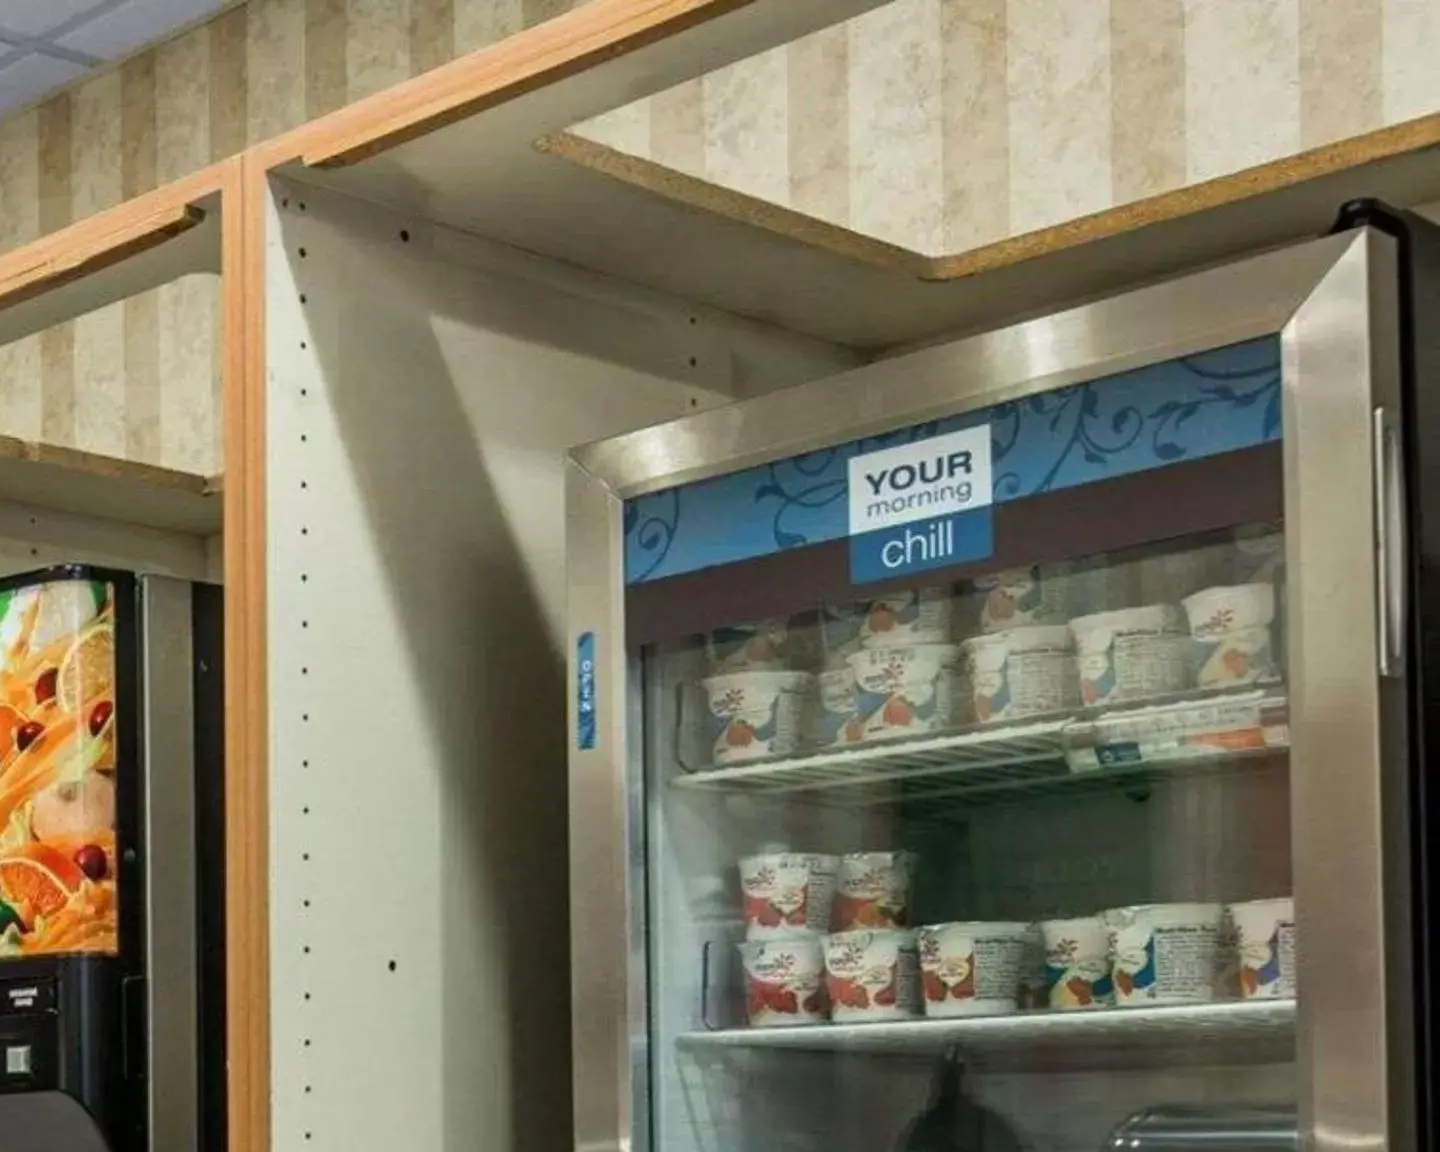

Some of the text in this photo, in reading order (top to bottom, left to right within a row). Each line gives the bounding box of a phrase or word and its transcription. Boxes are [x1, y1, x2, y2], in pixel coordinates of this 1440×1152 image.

[865, 451, 973, 496] YOUR
[866, 481, 973, 519] morning
[881, 520, 953, 568] chill
